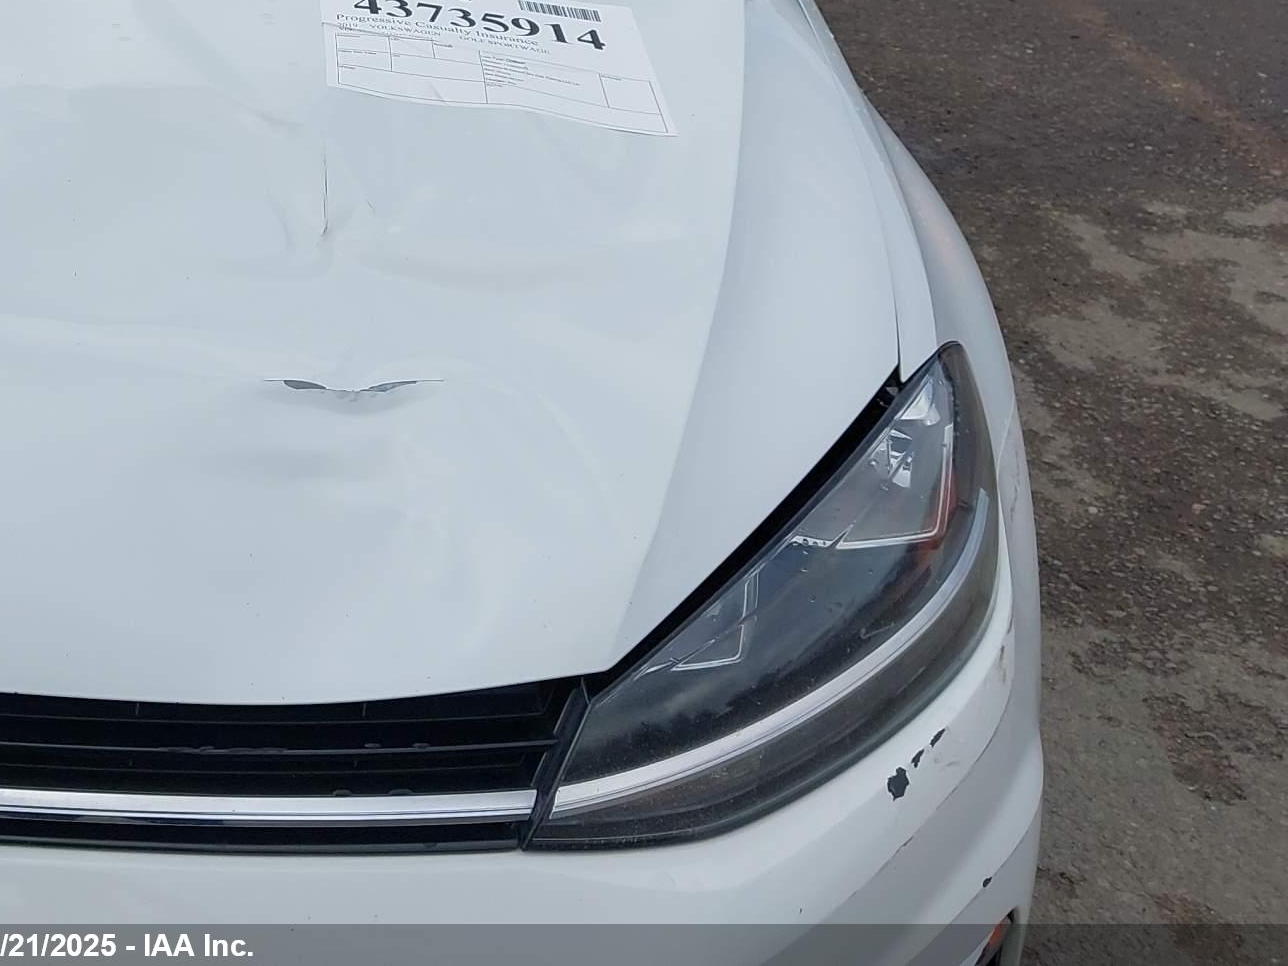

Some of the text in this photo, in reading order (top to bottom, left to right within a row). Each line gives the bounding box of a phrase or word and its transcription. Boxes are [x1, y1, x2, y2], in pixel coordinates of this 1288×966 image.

[336, 14, 539, 45] Progressive Casualty Insurance
[369, 23, 440, 36] VOLKSWAGEN
